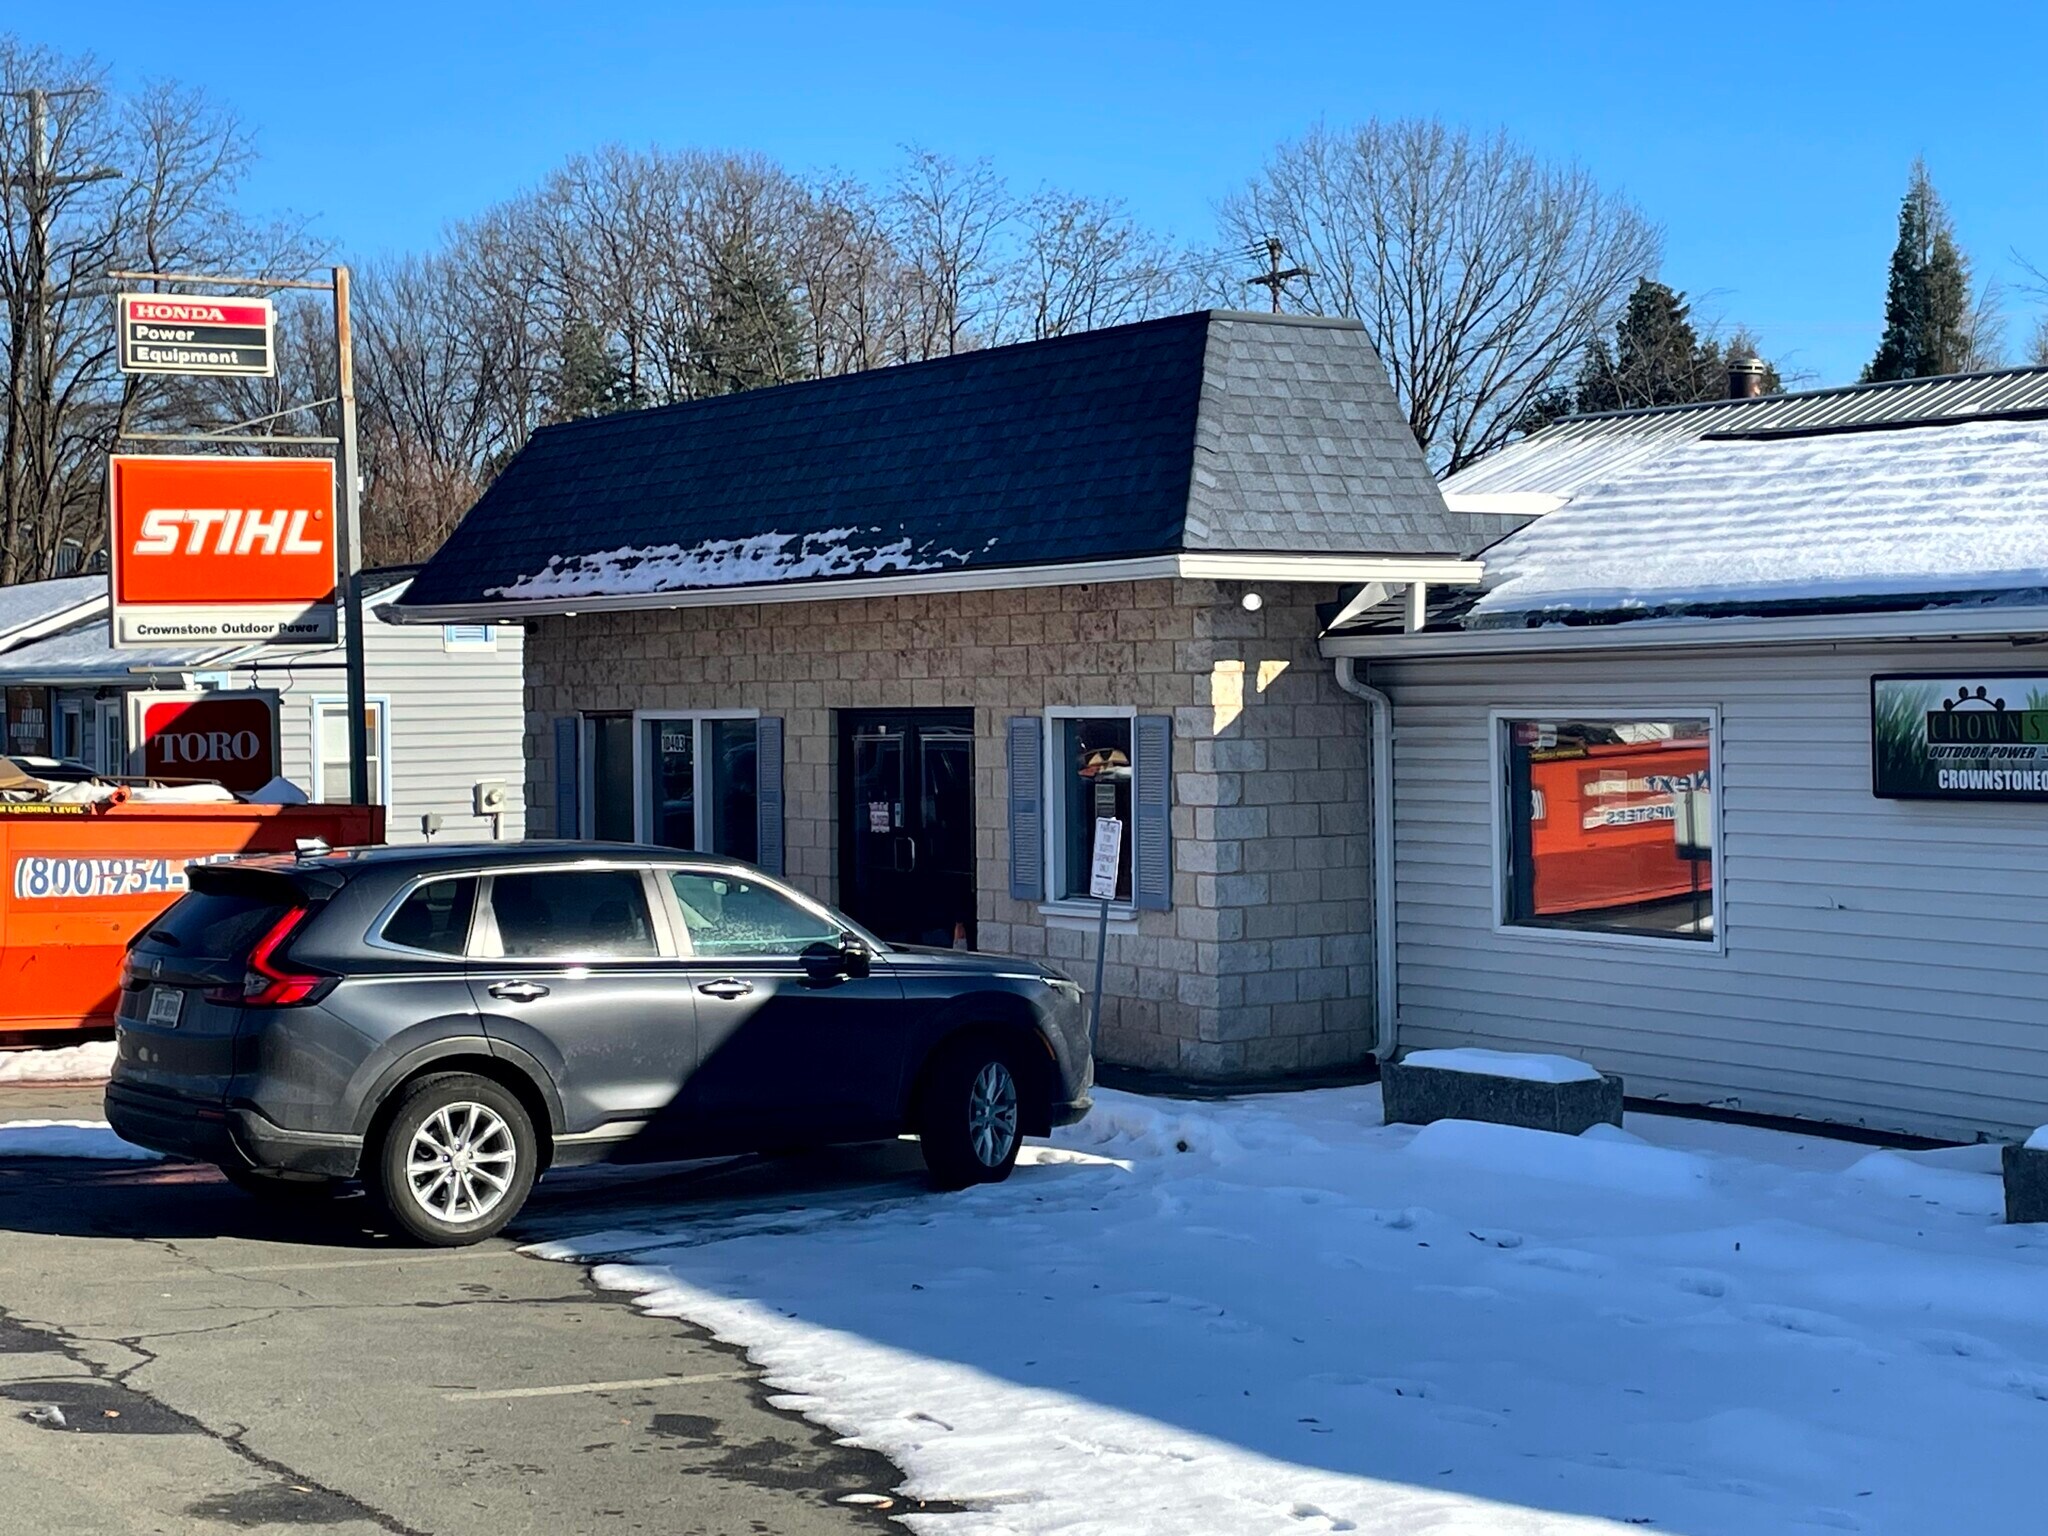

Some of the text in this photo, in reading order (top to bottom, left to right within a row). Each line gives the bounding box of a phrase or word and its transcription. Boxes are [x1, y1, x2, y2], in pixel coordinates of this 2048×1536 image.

[136, 304, 226, 321] HONDA
[136, 325, 195, 341] Power
[136, 346, 239, 364] Equipment
[133, 508, 323, 555] STIHL
[137, 623, 319, 635] Crownstone Outdoor Power
[154, 730, 260, 763] TORO
[1929, 746, 2038, 759] OUTDOOR POWER
[8, 805, 51, 814] LOADING
[53, 806, 84, 814] LEVEL
